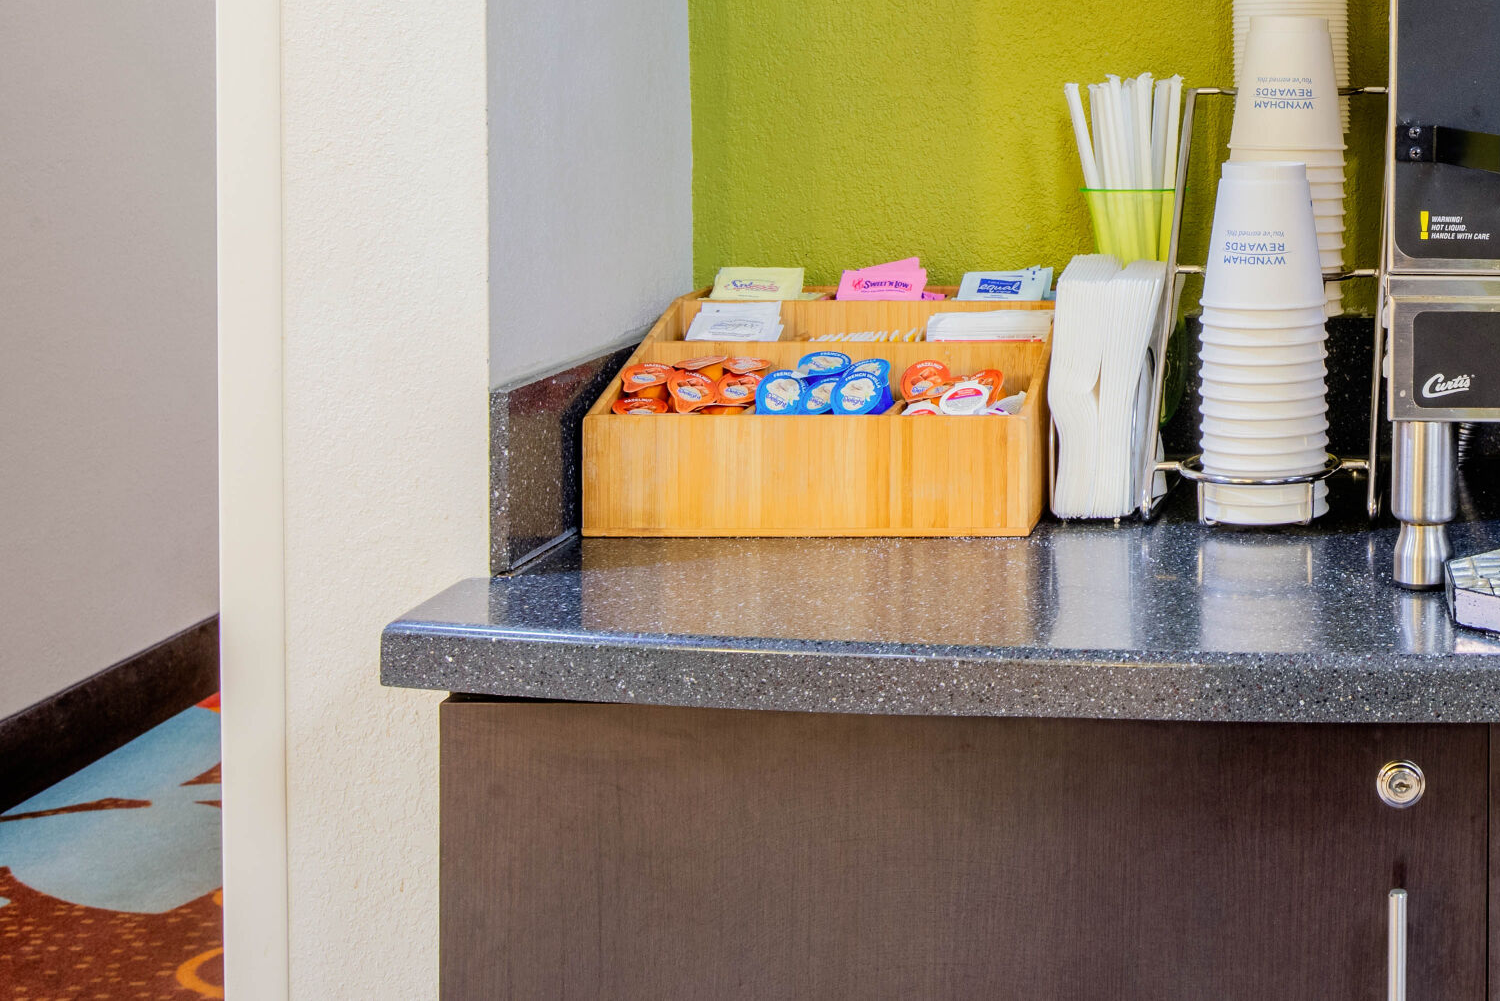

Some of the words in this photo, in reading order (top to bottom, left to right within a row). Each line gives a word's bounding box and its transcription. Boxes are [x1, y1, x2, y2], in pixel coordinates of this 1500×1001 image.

[1256, 88, 1312, 97] REWARDS
[1254, 101, 1314, 110] WYNDHAM
[1225, 242, 1285, 251] REWARDS
[1224, 255, 1286, 265] WYNDHAM
[980, 281, 1020, 293] equal
[1422, 373, 1470, 398] Curtis
